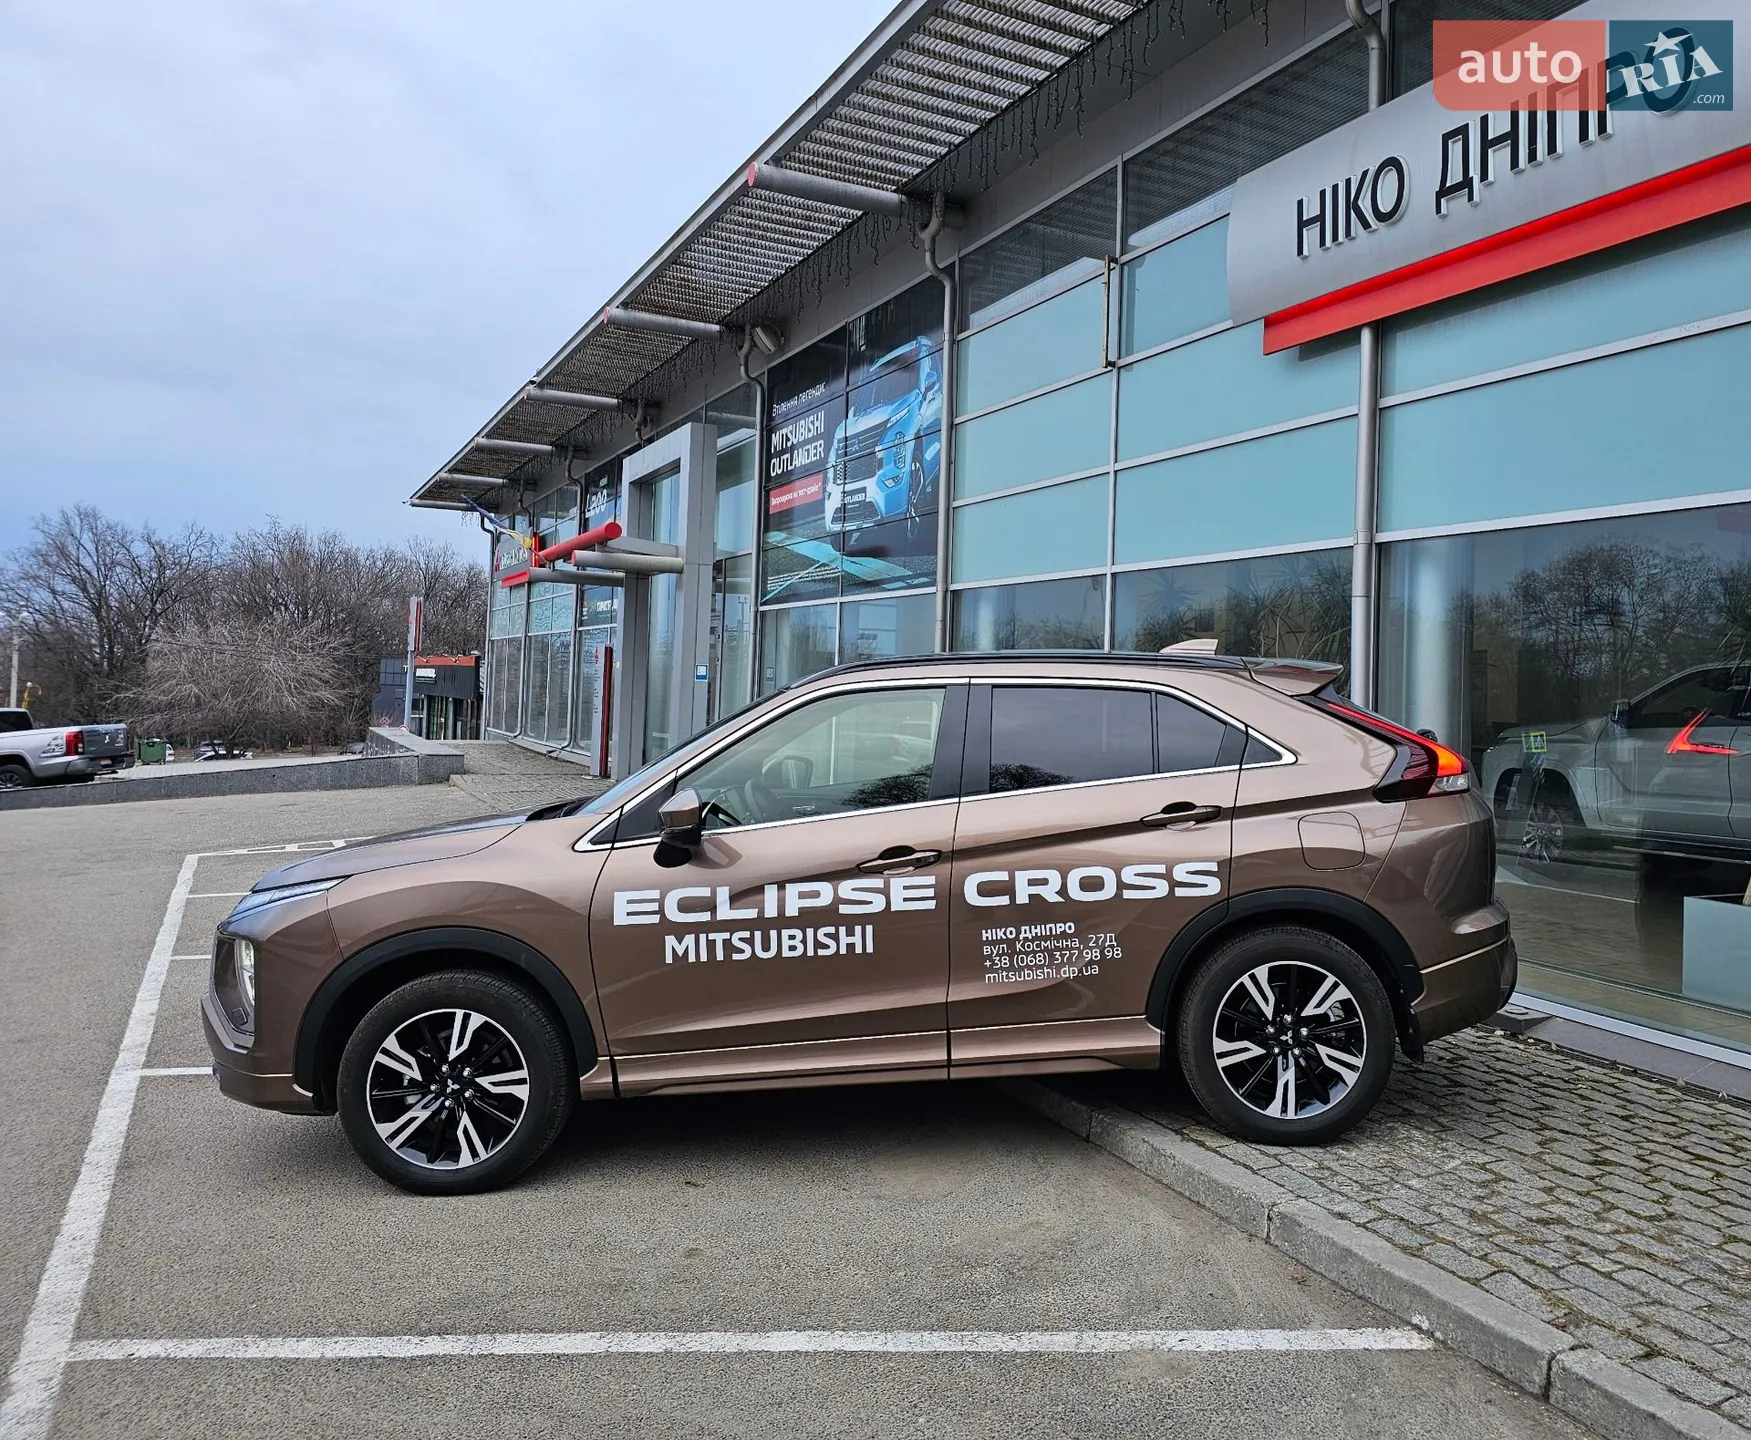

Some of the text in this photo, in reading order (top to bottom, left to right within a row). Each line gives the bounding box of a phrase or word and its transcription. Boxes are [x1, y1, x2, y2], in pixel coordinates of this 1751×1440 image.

[1296, 154, 1411, 260] НІКО
[771, 410, 825, 454] MITSUBISHI
[770, 439, 825, 477] OUTLANDER
[613, 861, 1222, 926] ECLIPSE CROSS
[664, 924, 874, 964] MITSUBISHI
[981, 921, 1076, 941] НІКО ДНІПРО
[983, 933, 1118, 958] вул. Космічна, 27Д
[983, 946, 1124, 970] +38 (068) 377 98 98
[984, 964, 1100, 984] mitsubishi.dp.ua
